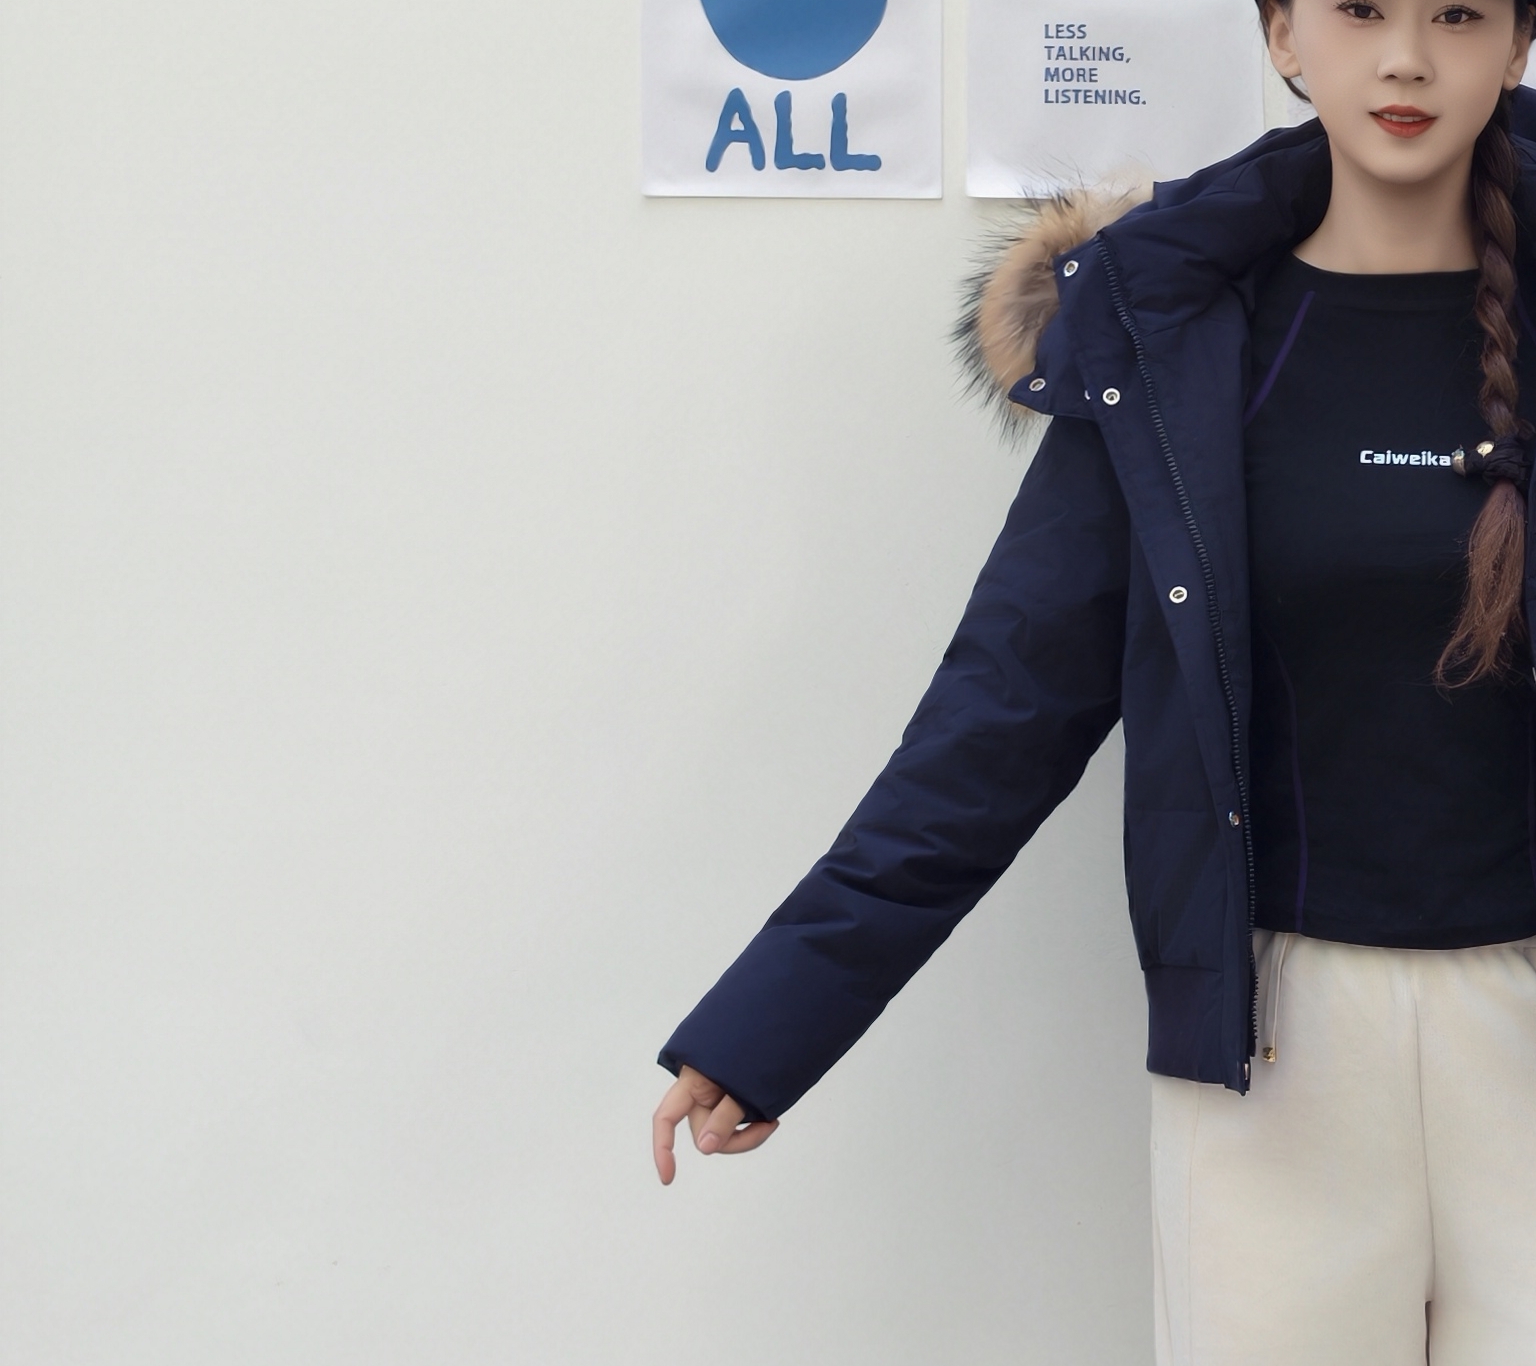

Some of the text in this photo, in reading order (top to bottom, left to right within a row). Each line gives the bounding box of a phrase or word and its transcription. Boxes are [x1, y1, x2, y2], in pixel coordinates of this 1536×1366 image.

[1044, 24, 1088, 40] LESS
[1044, 45, 1132, 64] TALKING,
[1044, 68, 1098, 84] MORE
[1044, 88, 1147, 106] LISTENING.
[705, 87, 882, 173] ALL
